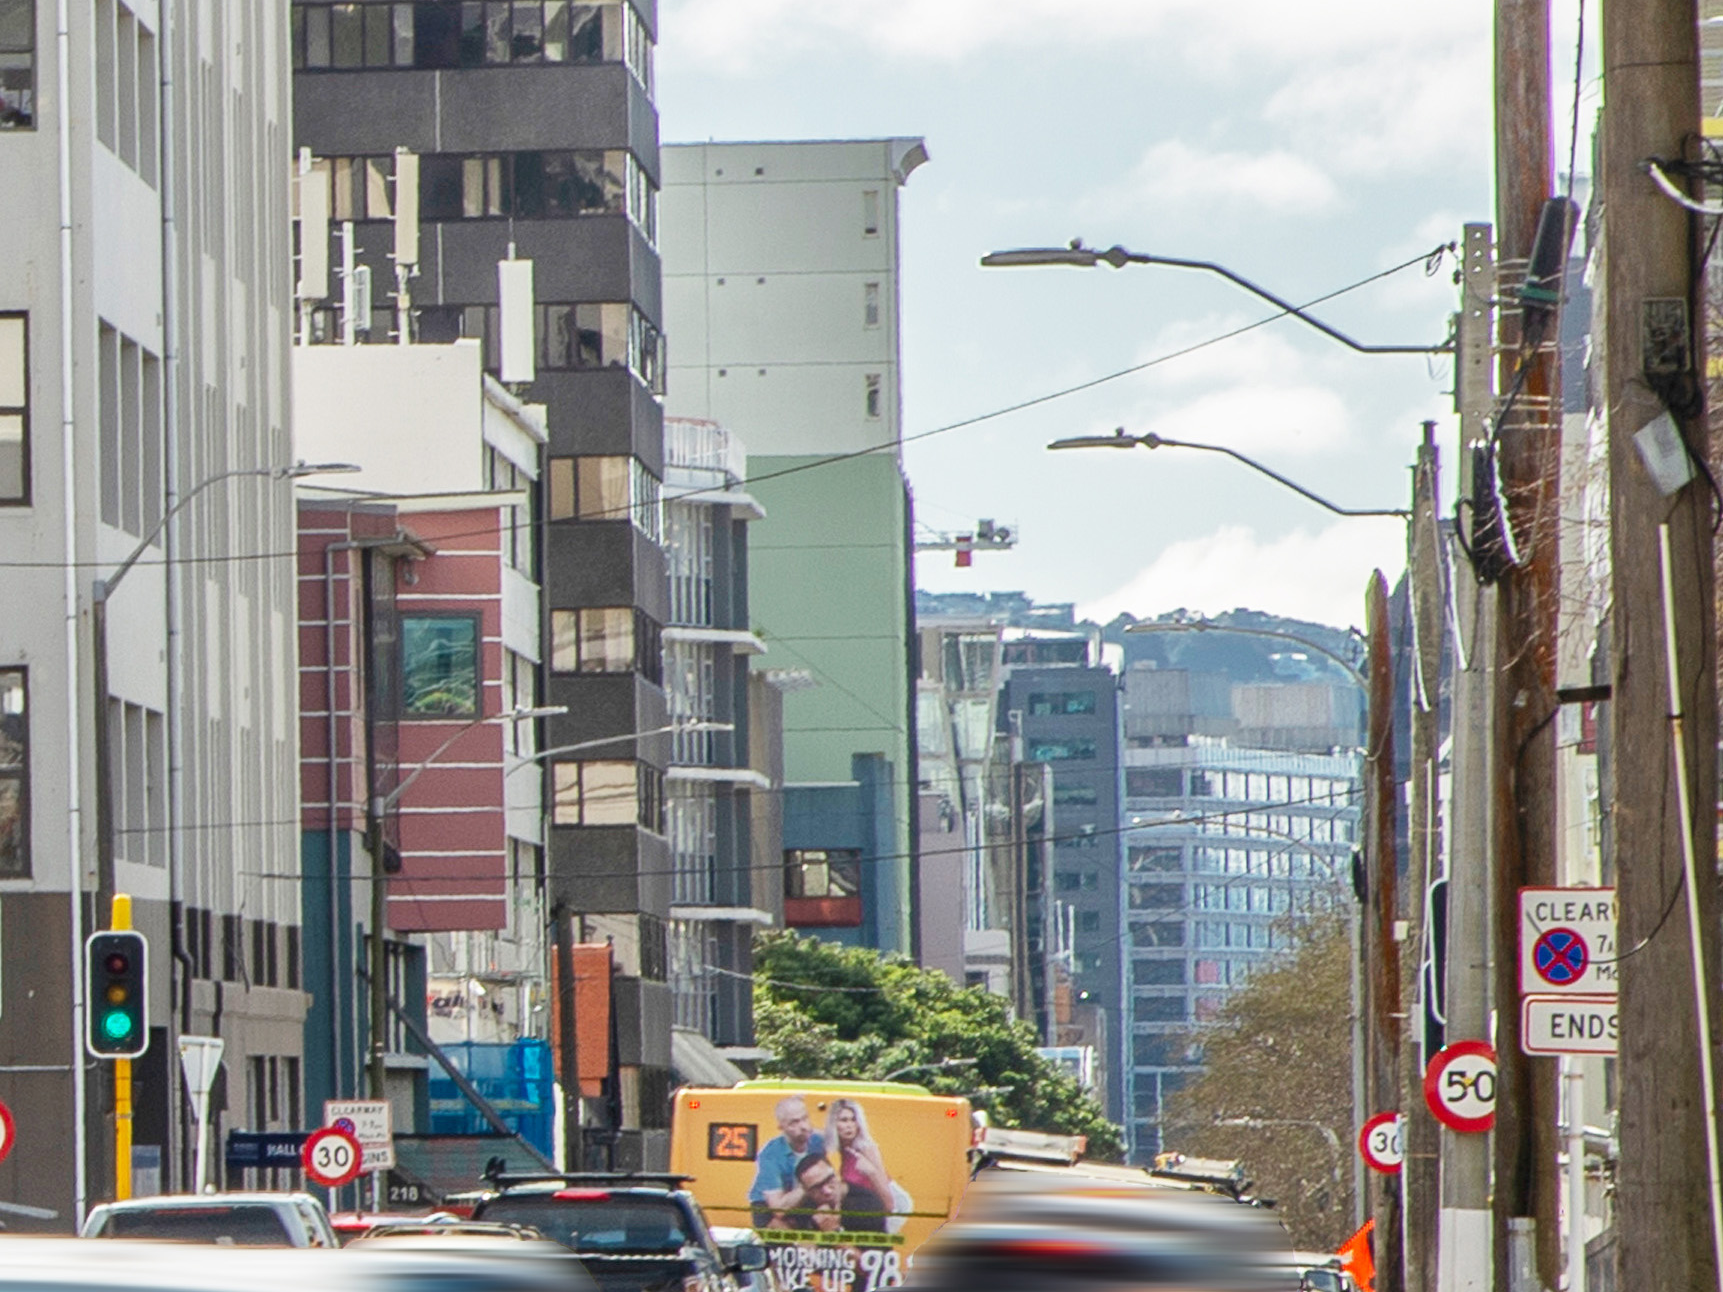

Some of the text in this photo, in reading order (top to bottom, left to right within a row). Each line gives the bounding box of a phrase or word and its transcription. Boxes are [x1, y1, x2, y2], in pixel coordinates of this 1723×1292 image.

[1535, 902, 1615, 922] CLEAR
[1550, 1014, 1619, 1040] ENDS
[1447, 1070, 1496, 1103] 50
[716, 1126, 749, 1157] 25
[317, 1145, 349, 1168] 30
[390, 1186, 419, 1202] 218
[768, 1247, 856, 1270] MORNING
